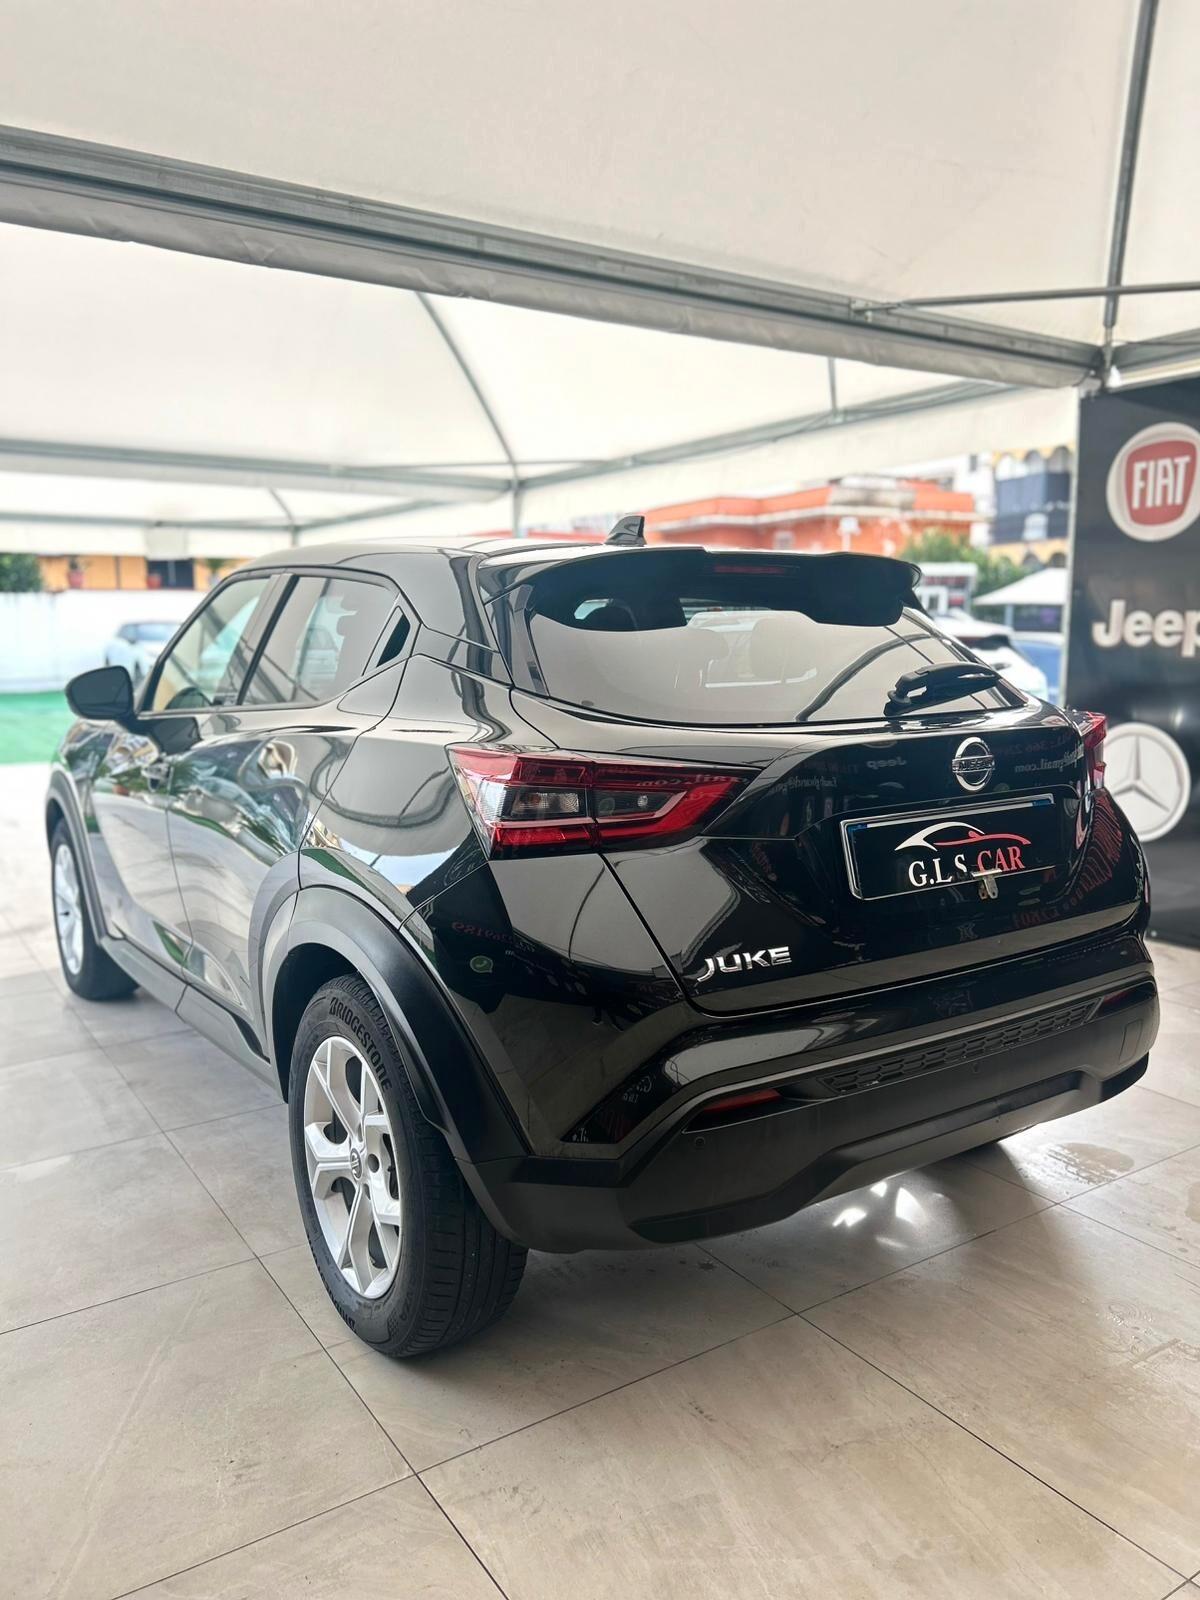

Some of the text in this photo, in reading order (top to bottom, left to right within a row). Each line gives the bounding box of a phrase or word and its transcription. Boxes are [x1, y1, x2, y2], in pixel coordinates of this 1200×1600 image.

[1132, 455, 1191, 510] FIAT
[976, 845, 1026, 873] CAR
[697, 947, 793, 983] JUKE
[329, 997, 393, 1093] BRIDGESTONE
